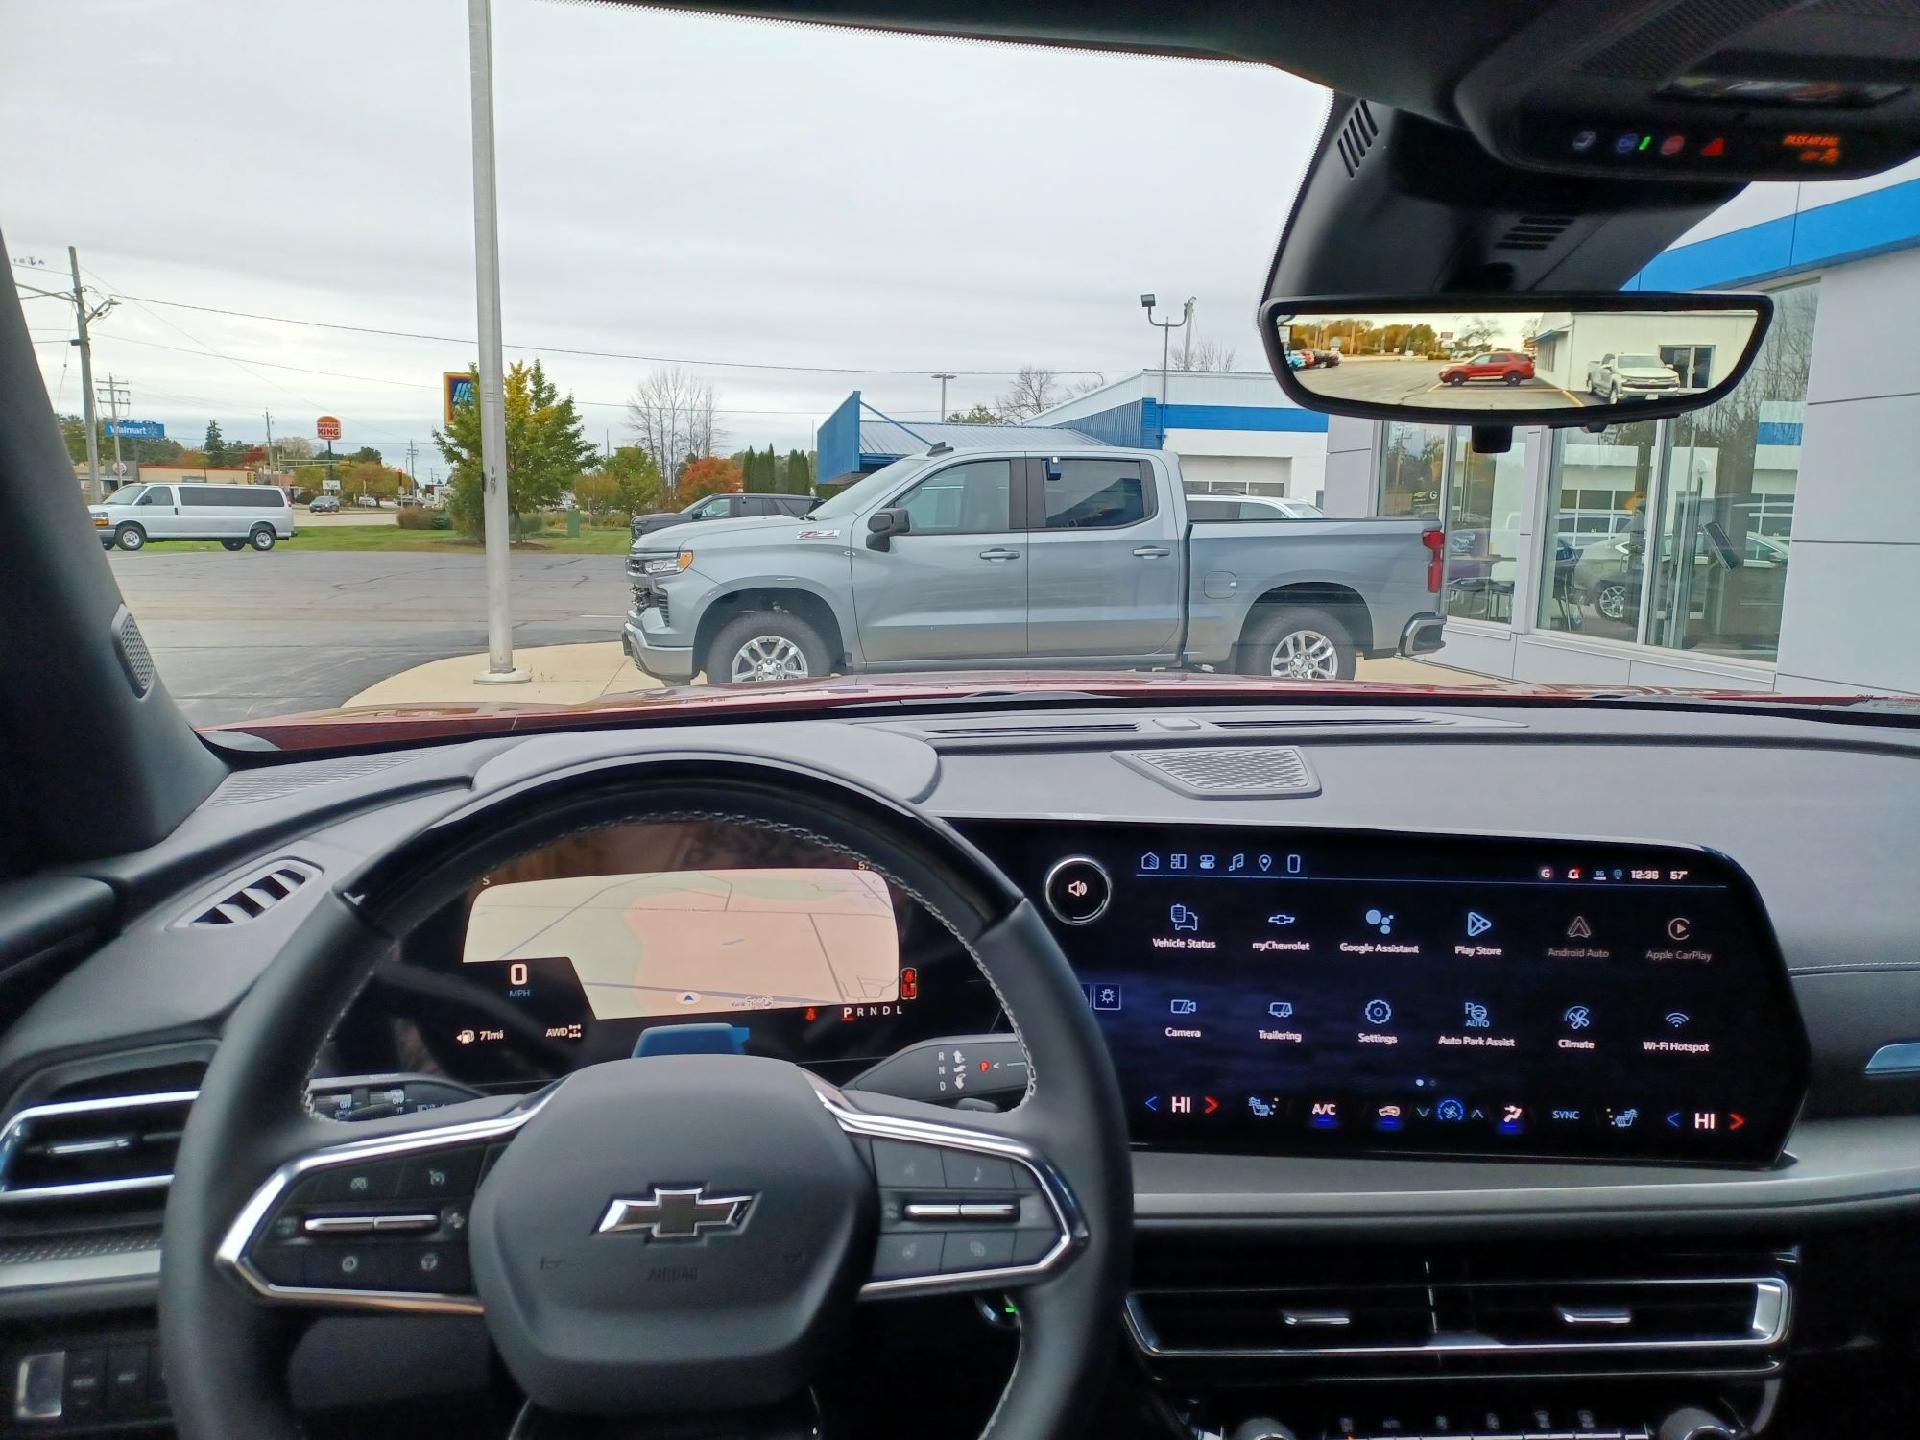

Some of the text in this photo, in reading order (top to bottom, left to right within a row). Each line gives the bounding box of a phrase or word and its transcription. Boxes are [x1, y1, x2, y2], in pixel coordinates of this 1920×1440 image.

[318, 428, 339, 436] KING
[1152, 938, 1216, 949] Vehicle Status
[1252, 940, 1310, 951] myChevrolet
[1339, 942, 1420, 954] Google Assistant
[1454, 946, 1502, 957] Play Store
[1548, 947, 1610, 958] Android Auto
[1645, 949, 1712, 962] Apple CarPlay
[510, 963, 528, 986] 0
[509, 989, 531, 998] MPH
[843, 1004, 903, 1019] P R N D L
[1465, 1019, 1490, 1028] AUTO
[545, 1027, 568, 1038] AWD
[1164, 1026, 1201, 1038] Camera
[1258, 1029, 1302, 1044] Trailering
[1357, 1032, 1398, 1045] Settings
[1438, 1035, 1516, 1047] Auto Park Assist
[1558, 1039, 1595, 1049] Climate
[1643, 1041, 1710, 1054] Wi-Fi Hotspot
[1171, 1096, 1191, 1114] HI
[1312, 1103, 1336, 1116] A/C
[1552, 1110, 1580, 1120] SYNC
[1694, 1112, 1716, 1130] HI
